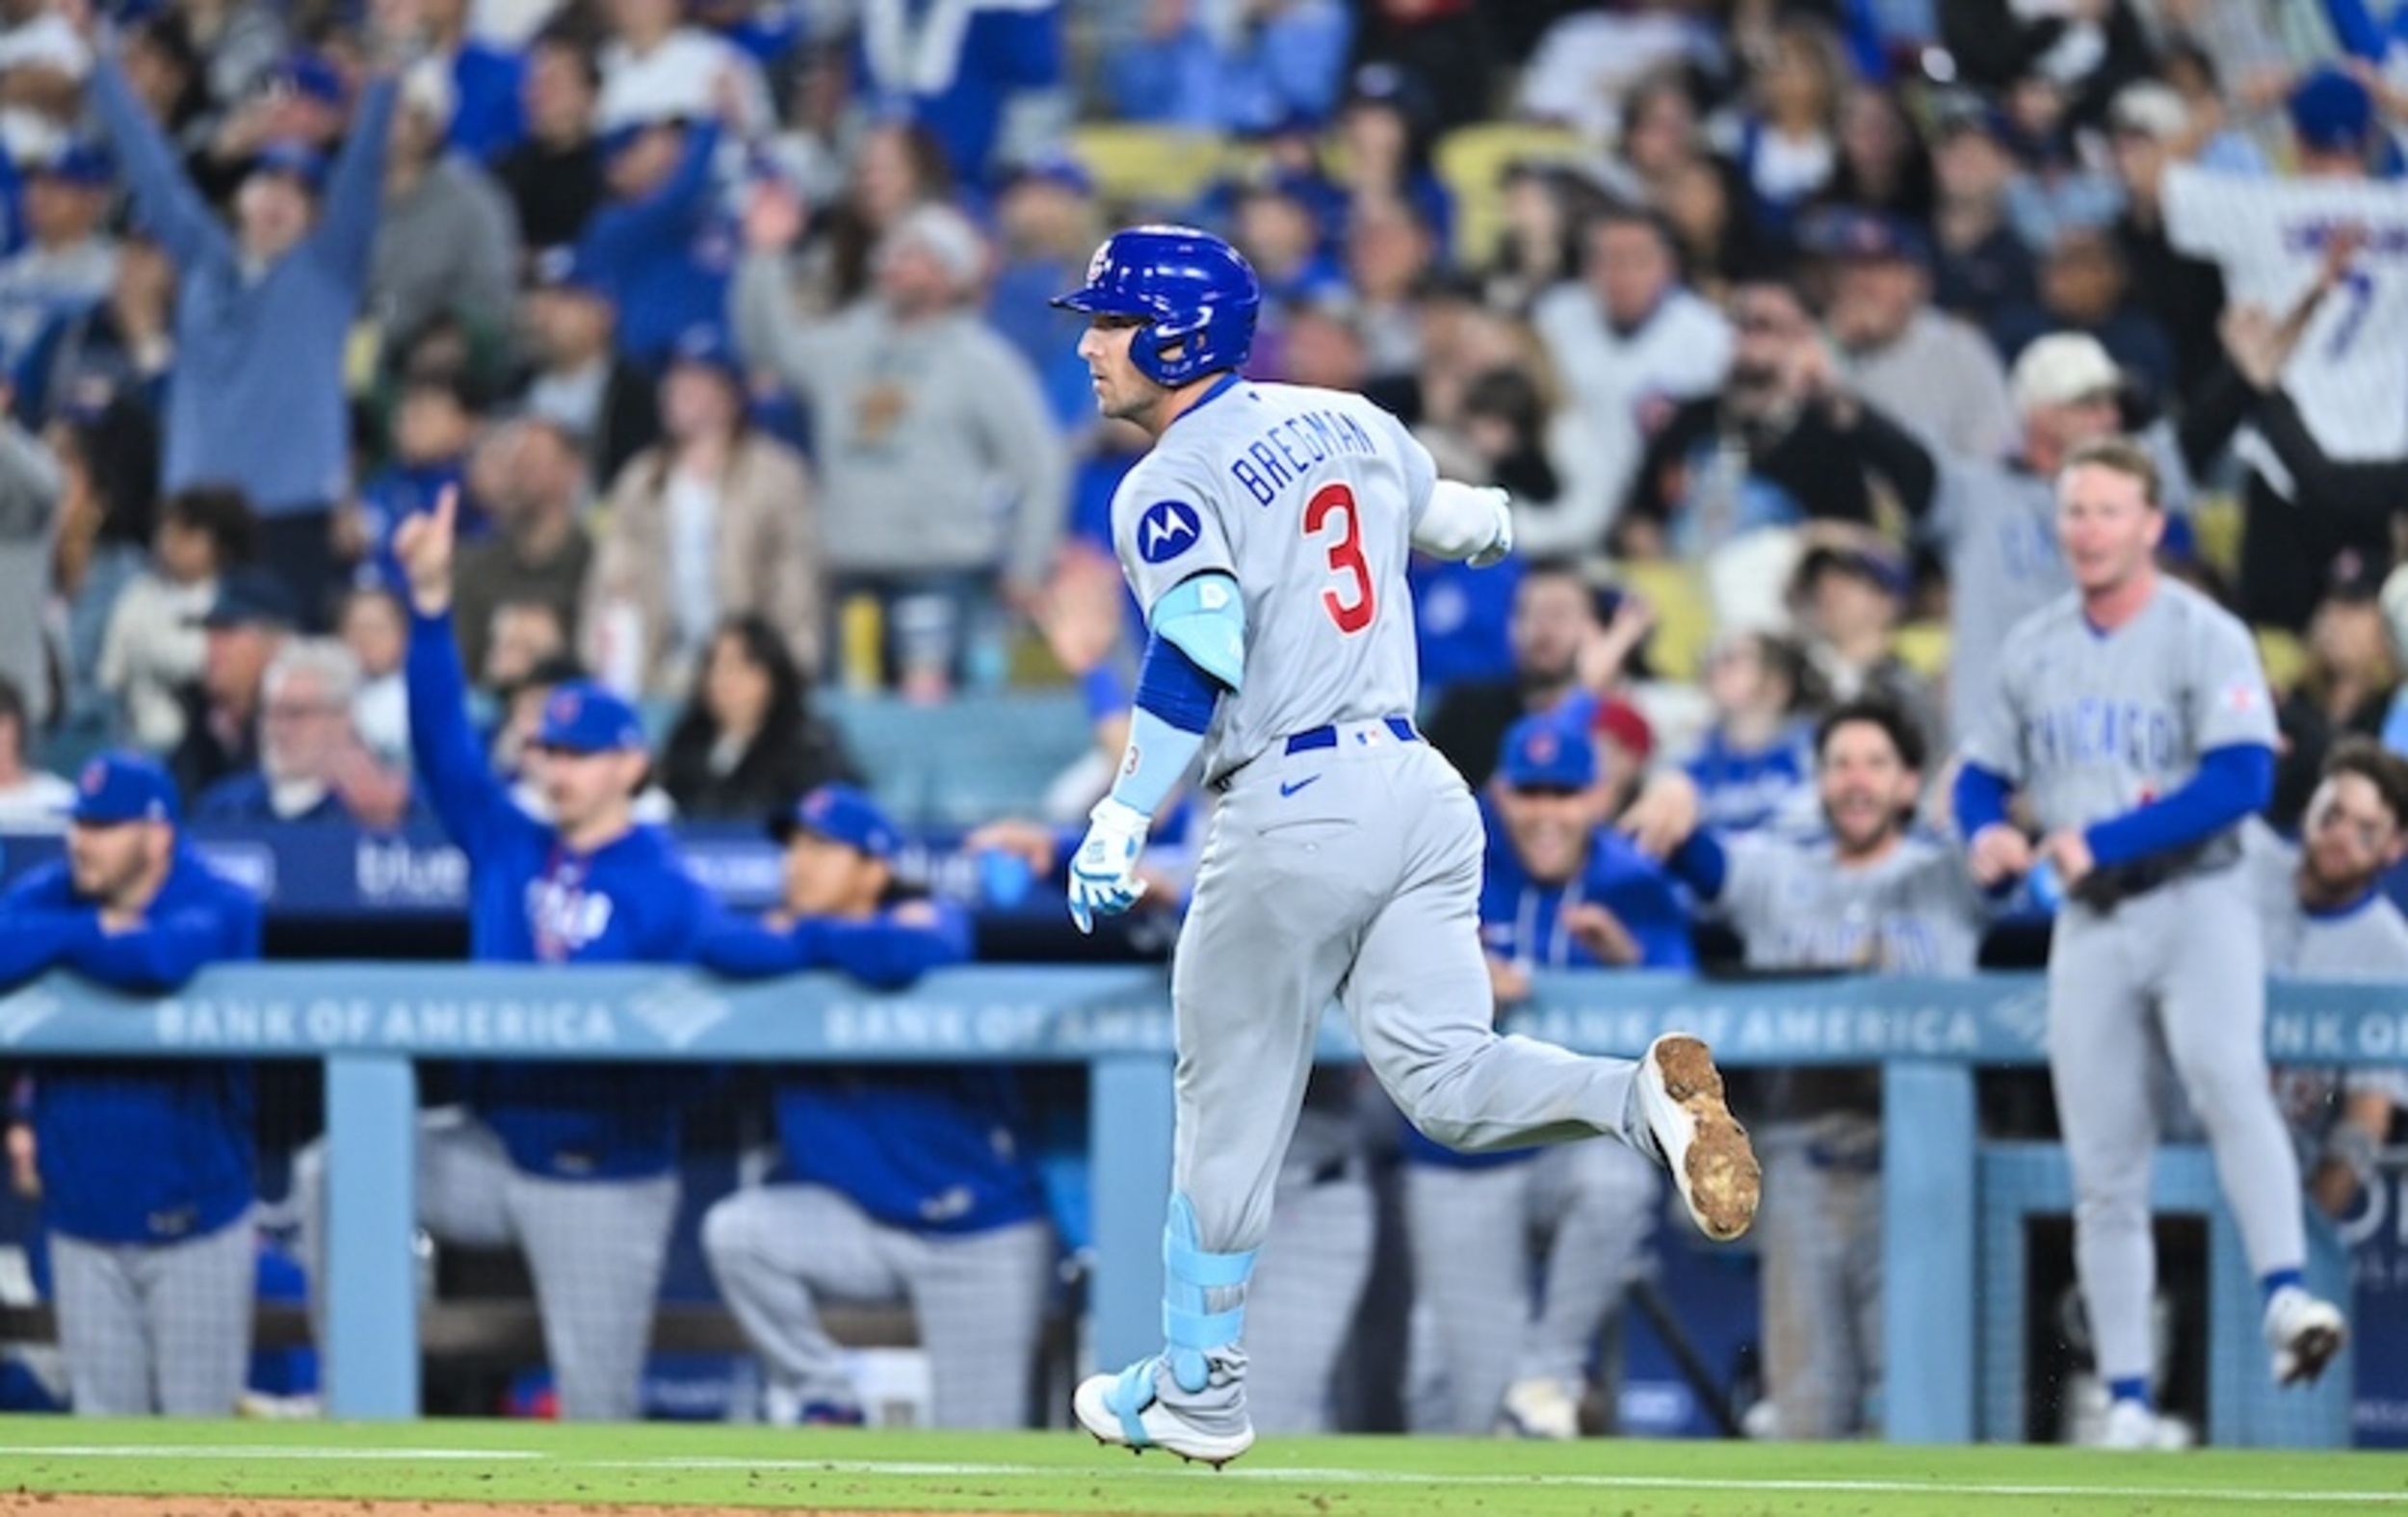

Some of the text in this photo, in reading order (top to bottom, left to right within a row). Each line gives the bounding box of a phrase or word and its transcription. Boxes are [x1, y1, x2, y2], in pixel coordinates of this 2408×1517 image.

[1231, 409, 1376, 507] BREGMAN
[1303, 482, 1375, 636] 3
[1125, 745, 1139, 775] 3
[355, 836, 470, 898] blue
[155, 999, 616, 1047] BANK OF AMERICA
[1739, 1006, 1979, 1055] AMERICA
[2269, 1009, 2346, 1058] NK
